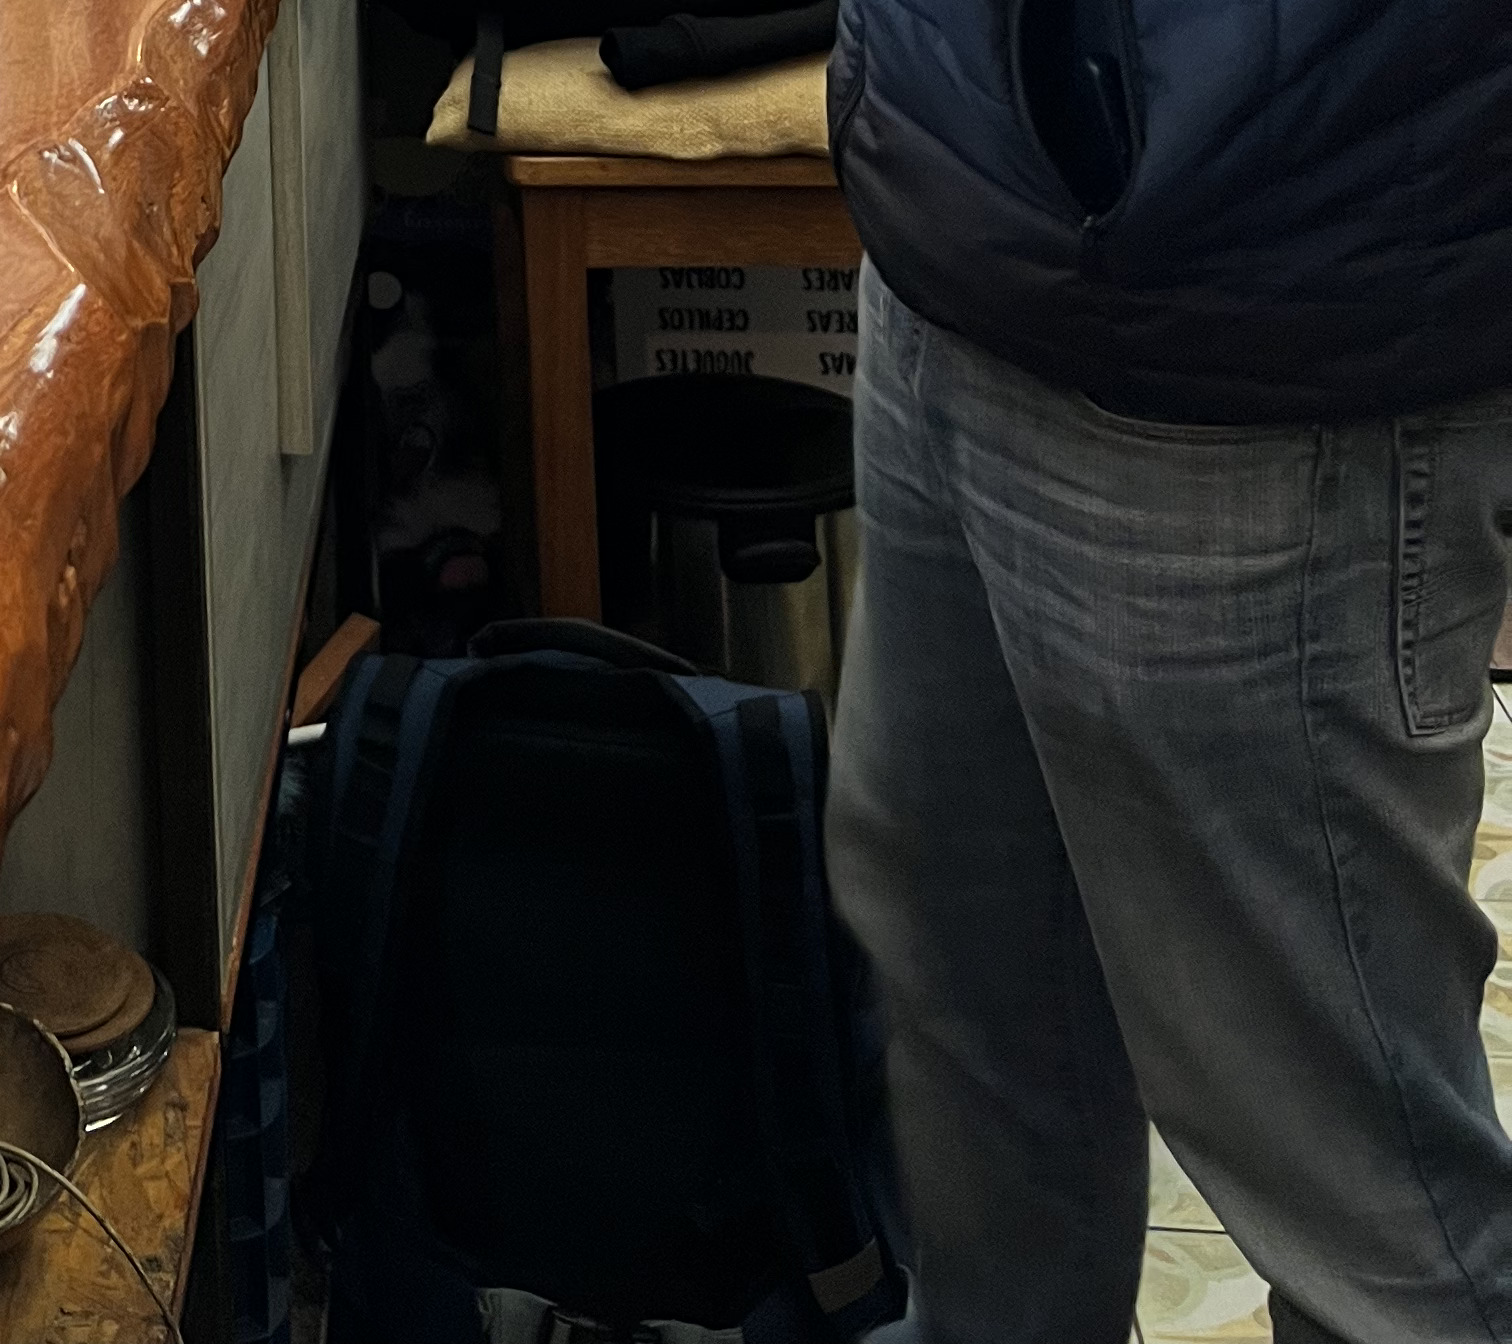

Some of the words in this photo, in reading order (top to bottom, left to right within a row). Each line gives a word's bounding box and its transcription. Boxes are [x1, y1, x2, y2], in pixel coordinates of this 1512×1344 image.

[659, 267, 745, 290] COBIJAS
[803, 267, 858, 291] ARES
[658, 307, 749, 331] CEPILLOS
[655, 348, 754, 374] JUGUETES
